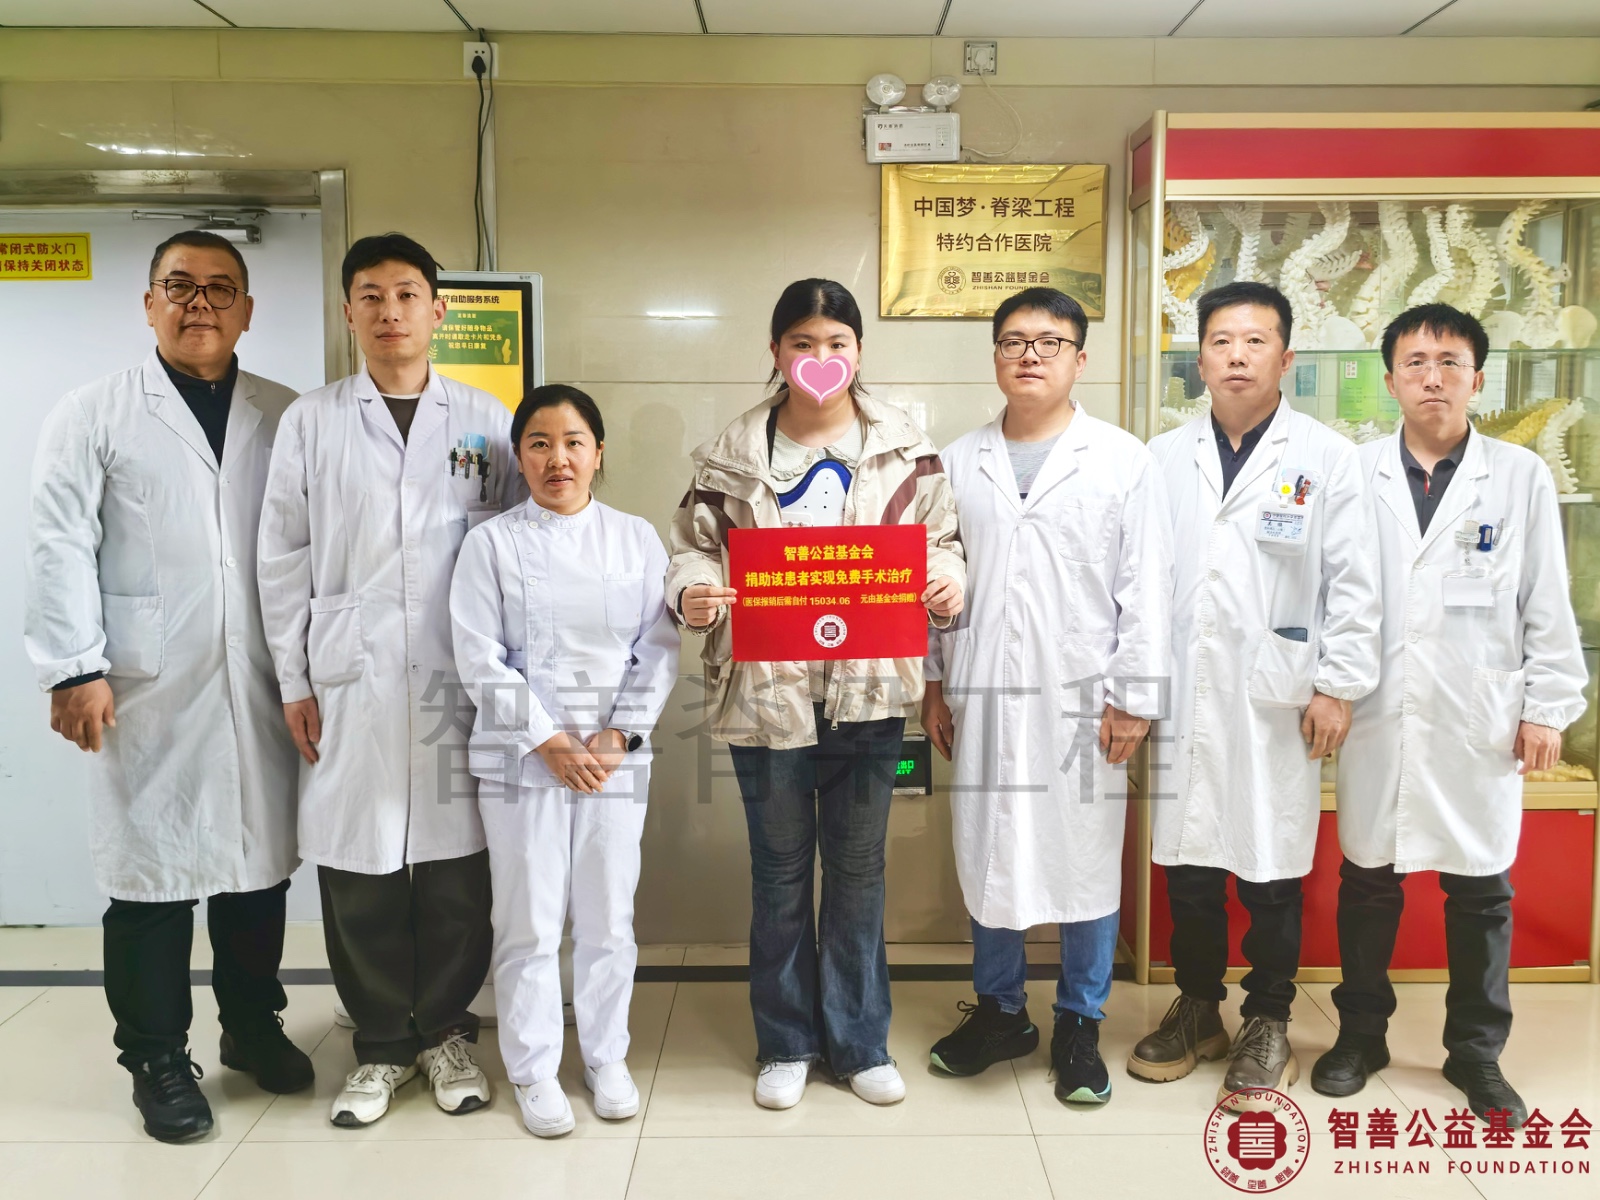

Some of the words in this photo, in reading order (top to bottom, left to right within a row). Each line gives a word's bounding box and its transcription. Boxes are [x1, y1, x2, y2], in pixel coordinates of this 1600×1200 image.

[914, 196, 1075, 218] 中国梦·脊梁工程
[0, 242, 76, 255] 常闭式防火门
[936, 232, 1053, 252] 特约合作医院
[0, 259, 84, 272] 保持关闭状态
[971, 271, 1050, 283] 智善公益基金会
[784, 544, 874, 561] 智善公益基金会
[745, 568, 912, 587] 捐助该患者实现免费手术治疗
[809, 596, 850, 606] 15034.06
[897, 760, 914, 770] 出口
